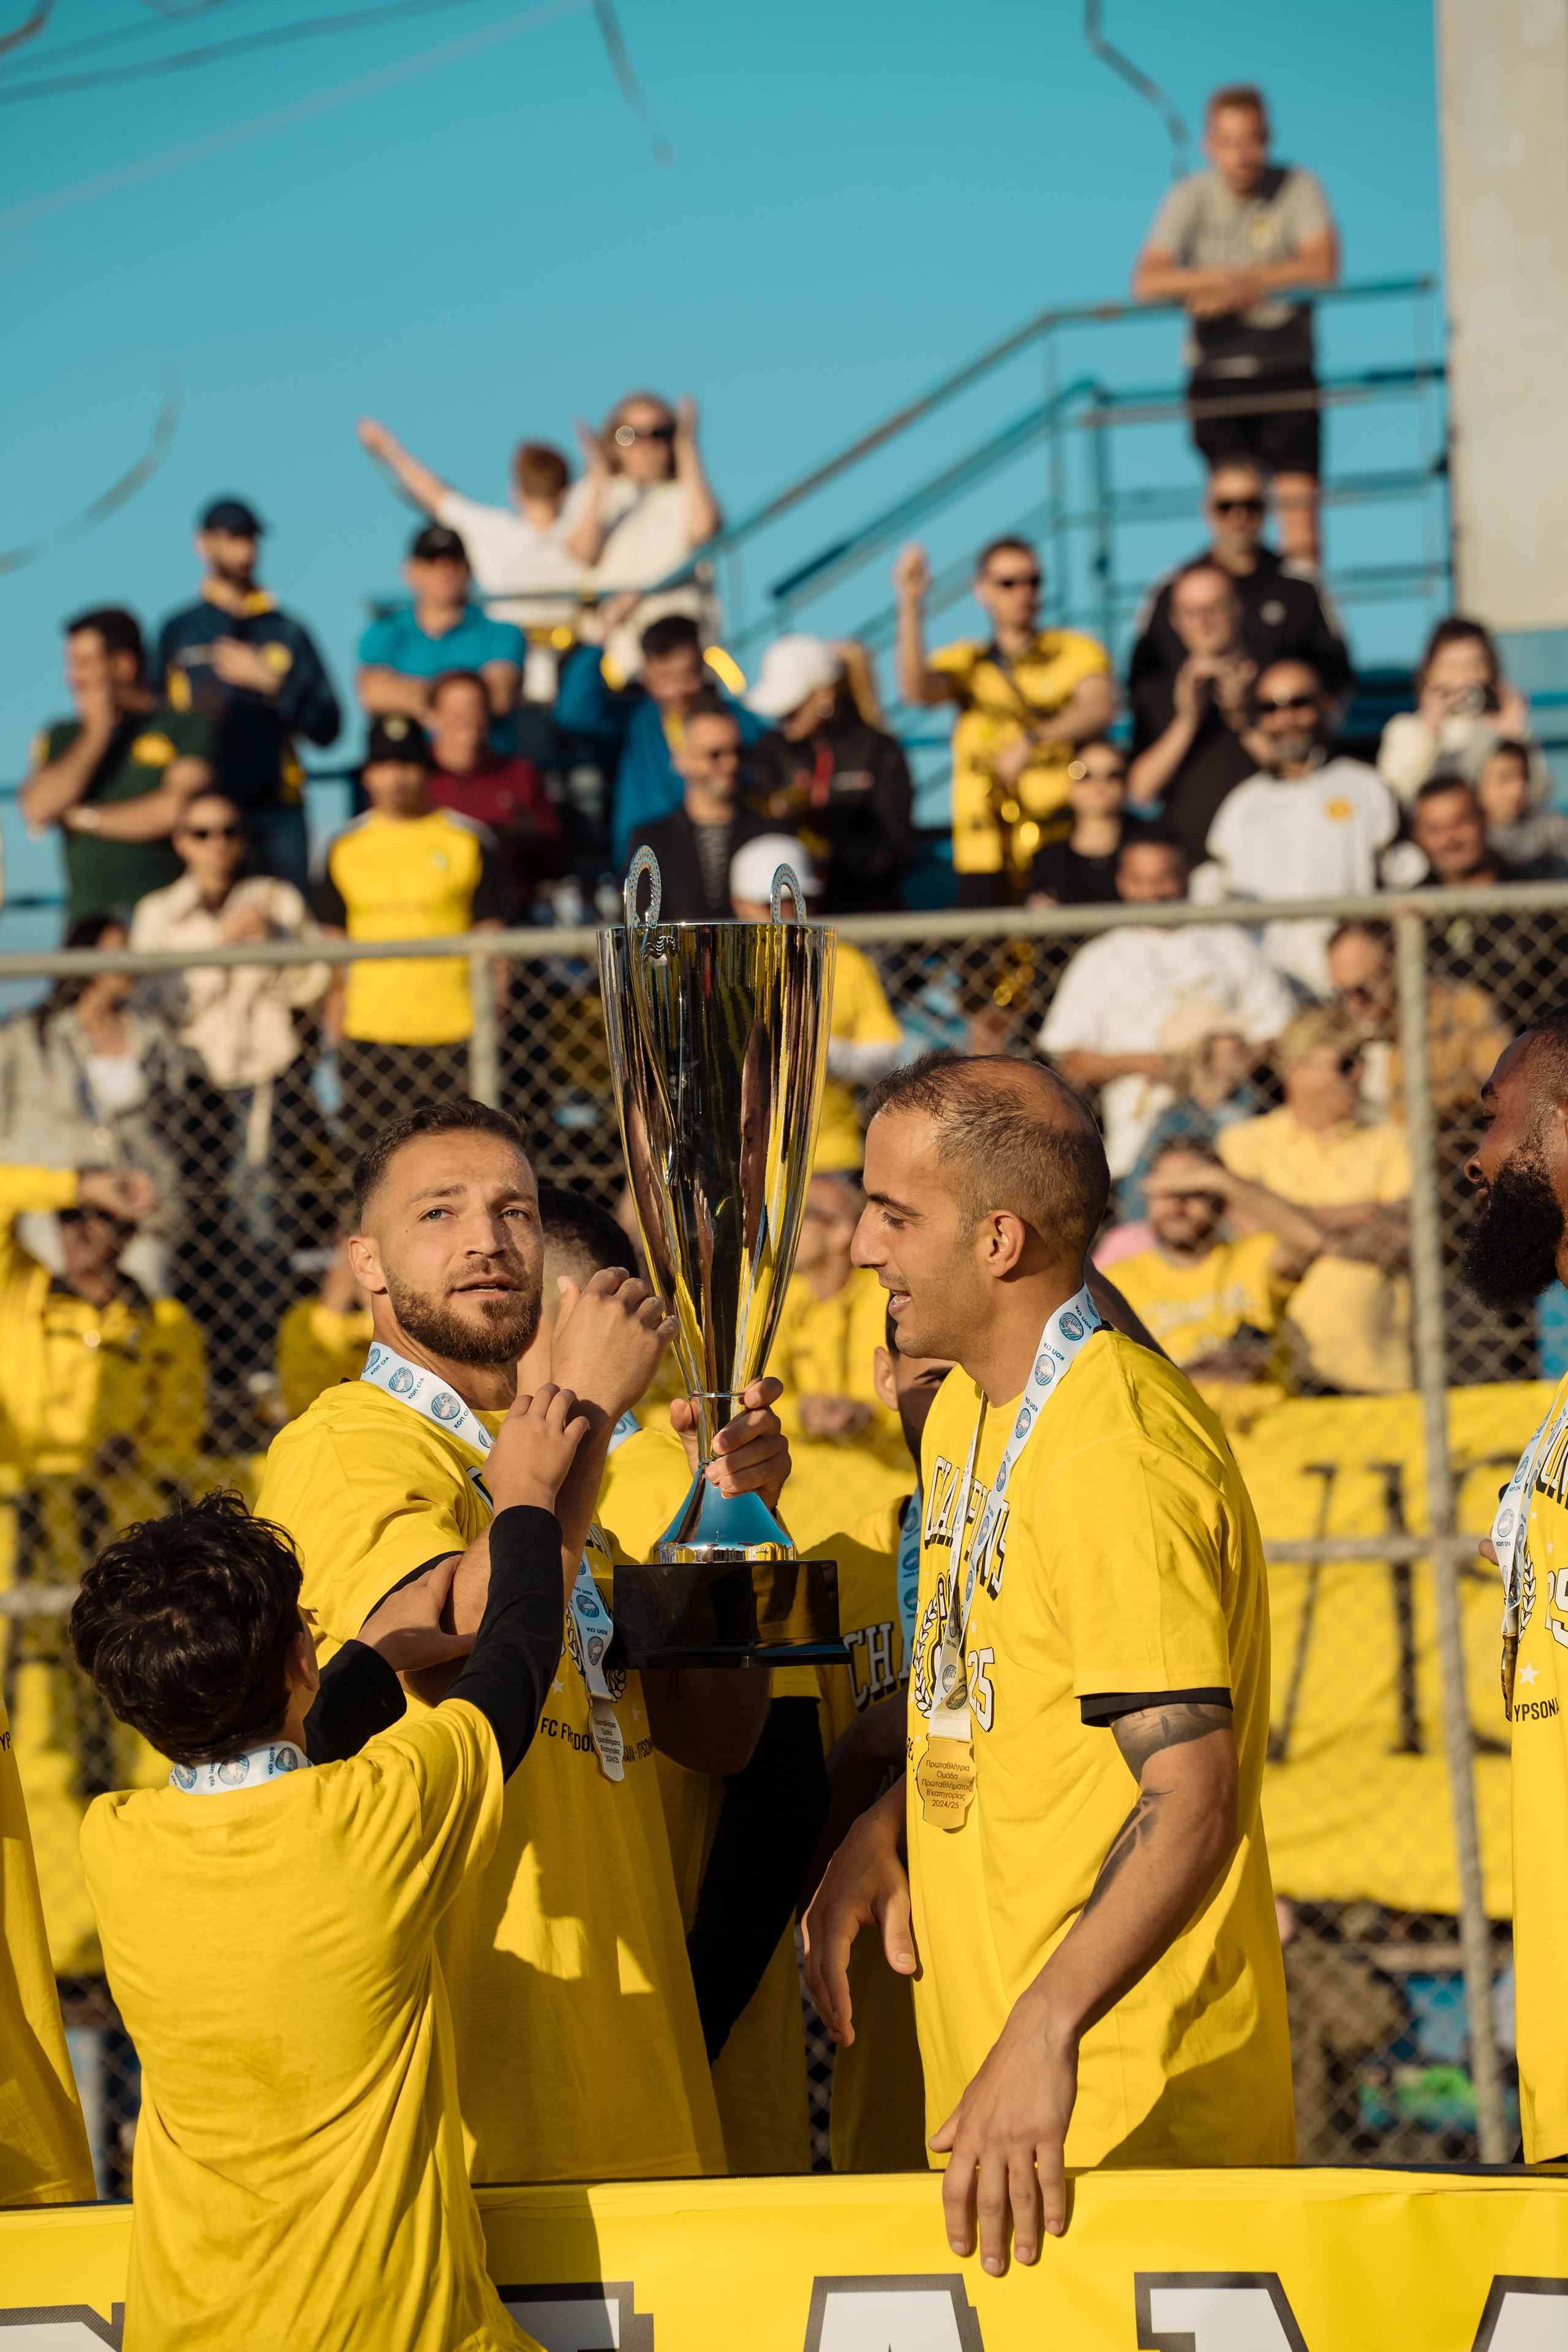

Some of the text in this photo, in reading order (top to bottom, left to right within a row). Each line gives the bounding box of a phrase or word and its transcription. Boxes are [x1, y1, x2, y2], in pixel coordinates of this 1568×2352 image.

[1044, 1342, 1052, 1351] CFA
[381, 1356, 390, 1365] CFA
[417, 1378, 425, 1389] CFA
[967, 1647, 995, 1733] 25
[540, 1717, 558, 1737] FC
[926, 1760, 970, 1772] Πρωταθλήτρια
[937, 1770, 958, 1780] Ομάδα
[921, 1778, 972, 1792] Πρωταθλήματος
[932, 1799, 959, 1809] 2024/25
